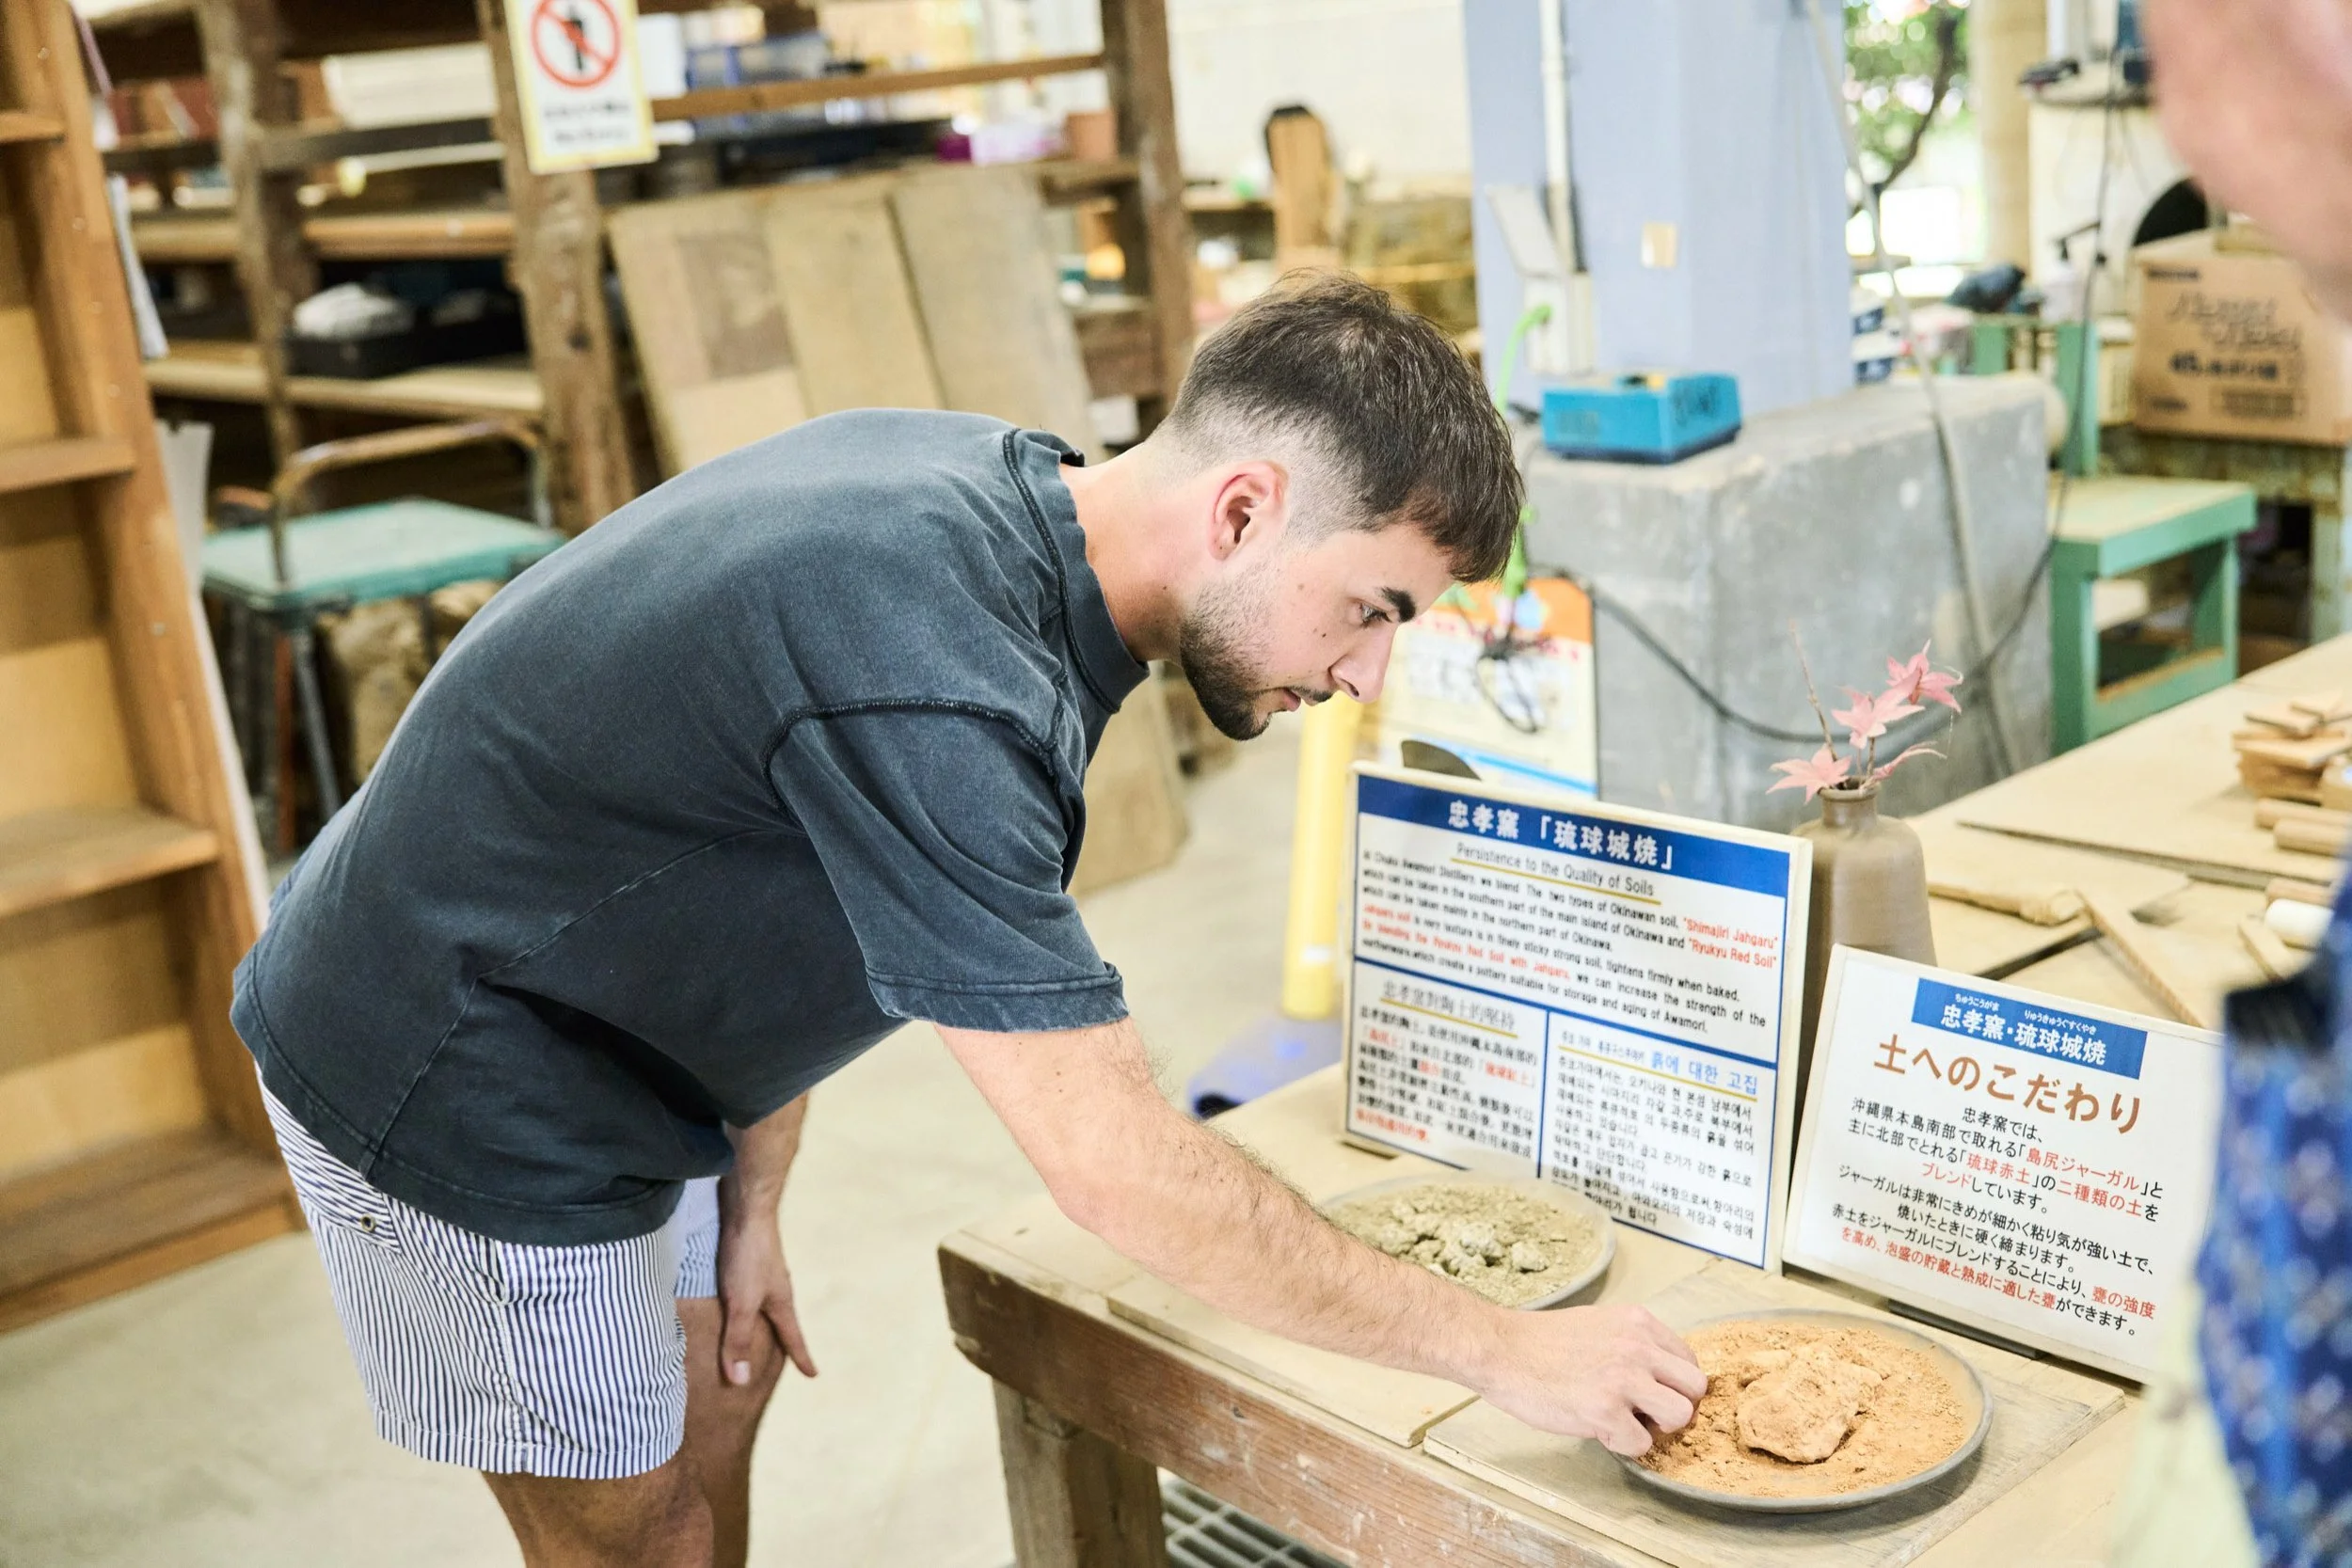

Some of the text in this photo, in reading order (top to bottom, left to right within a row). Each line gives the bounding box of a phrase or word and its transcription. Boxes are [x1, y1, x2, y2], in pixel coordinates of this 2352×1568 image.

[1447, 797, 1674, 871] 忠孝窯 「琉球城焼」
[1456, 842, 1655, 896] Persistence to the Quality of Soils
[1452, 887, 1465, 898] the
[1468, 891, 1504, 908] southern
[1507, 899, 1525, 912] part
[1528, 904, 1537, 915] of
[1539, 907, 1554, 919] the
[1556, 911, 1578, 925] main
[1581, 916, 1608, 931] island
[1610, 921, 1621, 934] of
[1622, 924, 1664, 943] Okinawa
[1666, 934, 1685, 949] and
[1729, 947, 1751, 964] Red
[1480, 878, 1492, 887] we
[1526, 884, 1542, 897] The
[1549, 892, 1565, 902] two
[1567, 895, 1594, 910] types
[1597, 900, 1607, 912] of
[1609, 902, 1657, 923] Okinawan
[1482, 911, 1495, 924] the
[1499, 915, 1534, 932] northern
[1538, 925, 1556, 938] part
[1560, 928, 1569, 941] of
[1497, 934, 1520, 949] finely
[1523, 941, 1549, 957] sticky
[1552, 949, 1581, 964] strong
[1605, 960, 1644, 979] tightens
[1646, 969, 1674, 987] firmly
[1676, 976, 1704, 992] when
[1705, 983, 1740, 1002] baked.
[1509, 974, 1544, 990] suitable
[1547, 983, 1559, 995] for
[1563, 988, 1597, 1006] storage
[1601, 996, 1618, 1009] and
[1621, 1003, 1647, 1018] aging
[1650, 1007, 1661, 1021] of
[1662, 1011, 1708, 1032] Awamori.
[1576, 974, 1589, 983] we
[1595, 977, 1612, 990] can
[1617, 983, 1658, 1001] increase
[1662, 992, 1679, 1006] the
[1684, 997, 1727, 1019] strength
[1731, 1007, 1743, 1022] of
[1748, 1012, 1767, 1027] the
[1953, 992, 2098, 1037] ちゅうこうがま りゅうきゅうぐすくやき
[1939, 1001, 2108, 1067] 忠孝窯・琉球城焼
[1650, 1050, 1679, 1075] 흙에
[1687, 1060, 1719, 1085] 대한
[1726, 1070, 1758, 1096] 고집
[1872, 1030, 2142, 1137] 土へのこだわり
[1709, 1096, 1752, 1121] 남부에서
[1709, 1113, 1753, 1139] 북부에서
[1961, 1104, 2045, 1143] 忠孝窯では、
[1847, 1116, 2159, 1223] 主に北部でとれる「琉球赤土」の二種類の土を
[1919, 1160, 2050, 1214] ブレンドしています。
[1837, 1163, 2156, 1275] ジャーガルは非常にきめが細かく粘り気が強い土で、
[1896, 1202, 2076, 1274] 焼いたときに硬く締まります。
